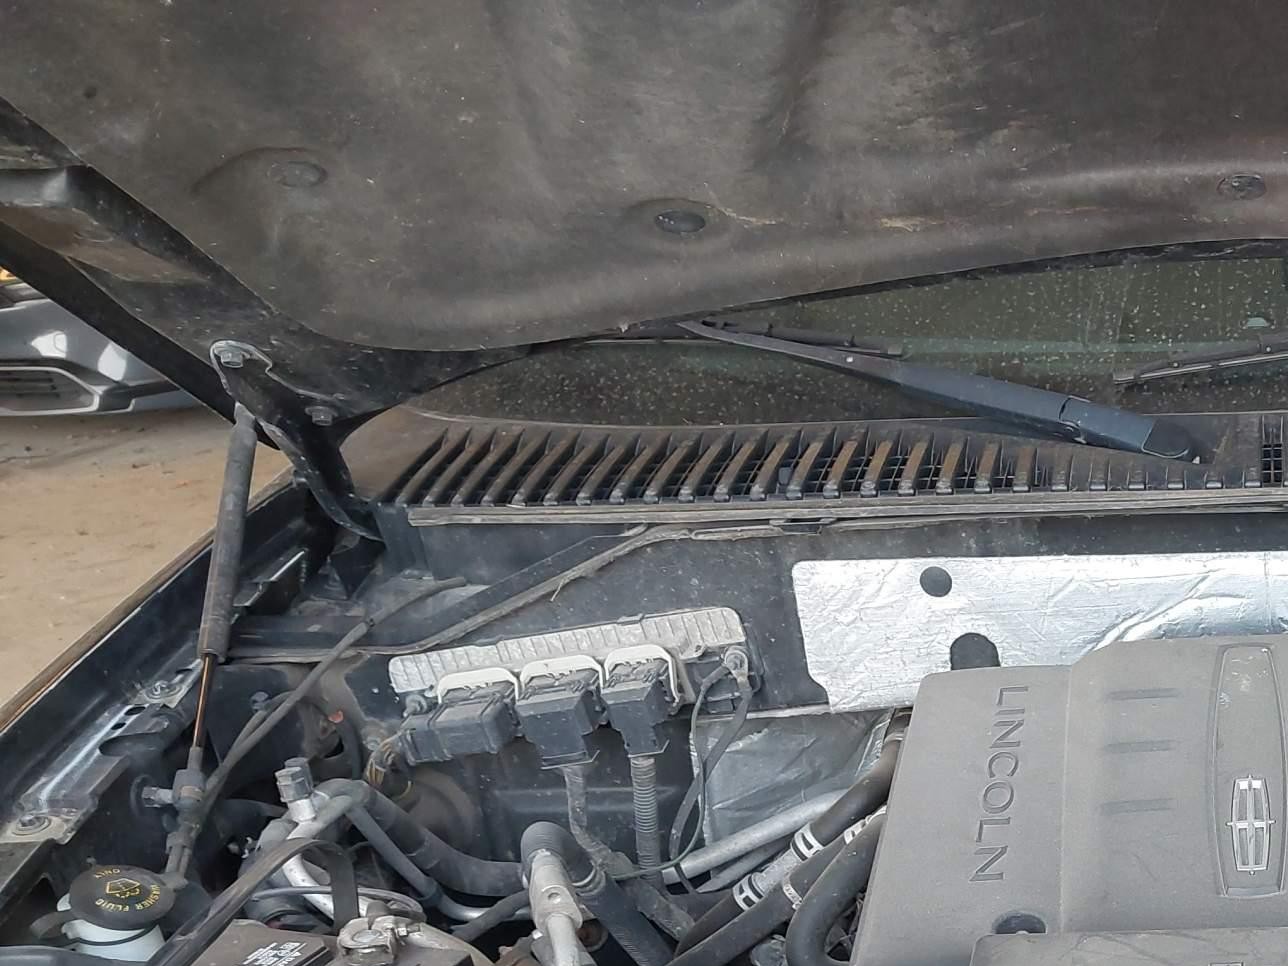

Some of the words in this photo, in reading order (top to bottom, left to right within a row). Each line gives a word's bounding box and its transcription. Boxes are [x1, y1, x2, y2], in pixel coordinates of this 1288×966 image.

[969, 686, 1029, 882] LINCOLN
[94, 868, 121, 880] ONLY
[95, 898, 130, 912] FLUID
[135, 884, 160, 911] WASHER
